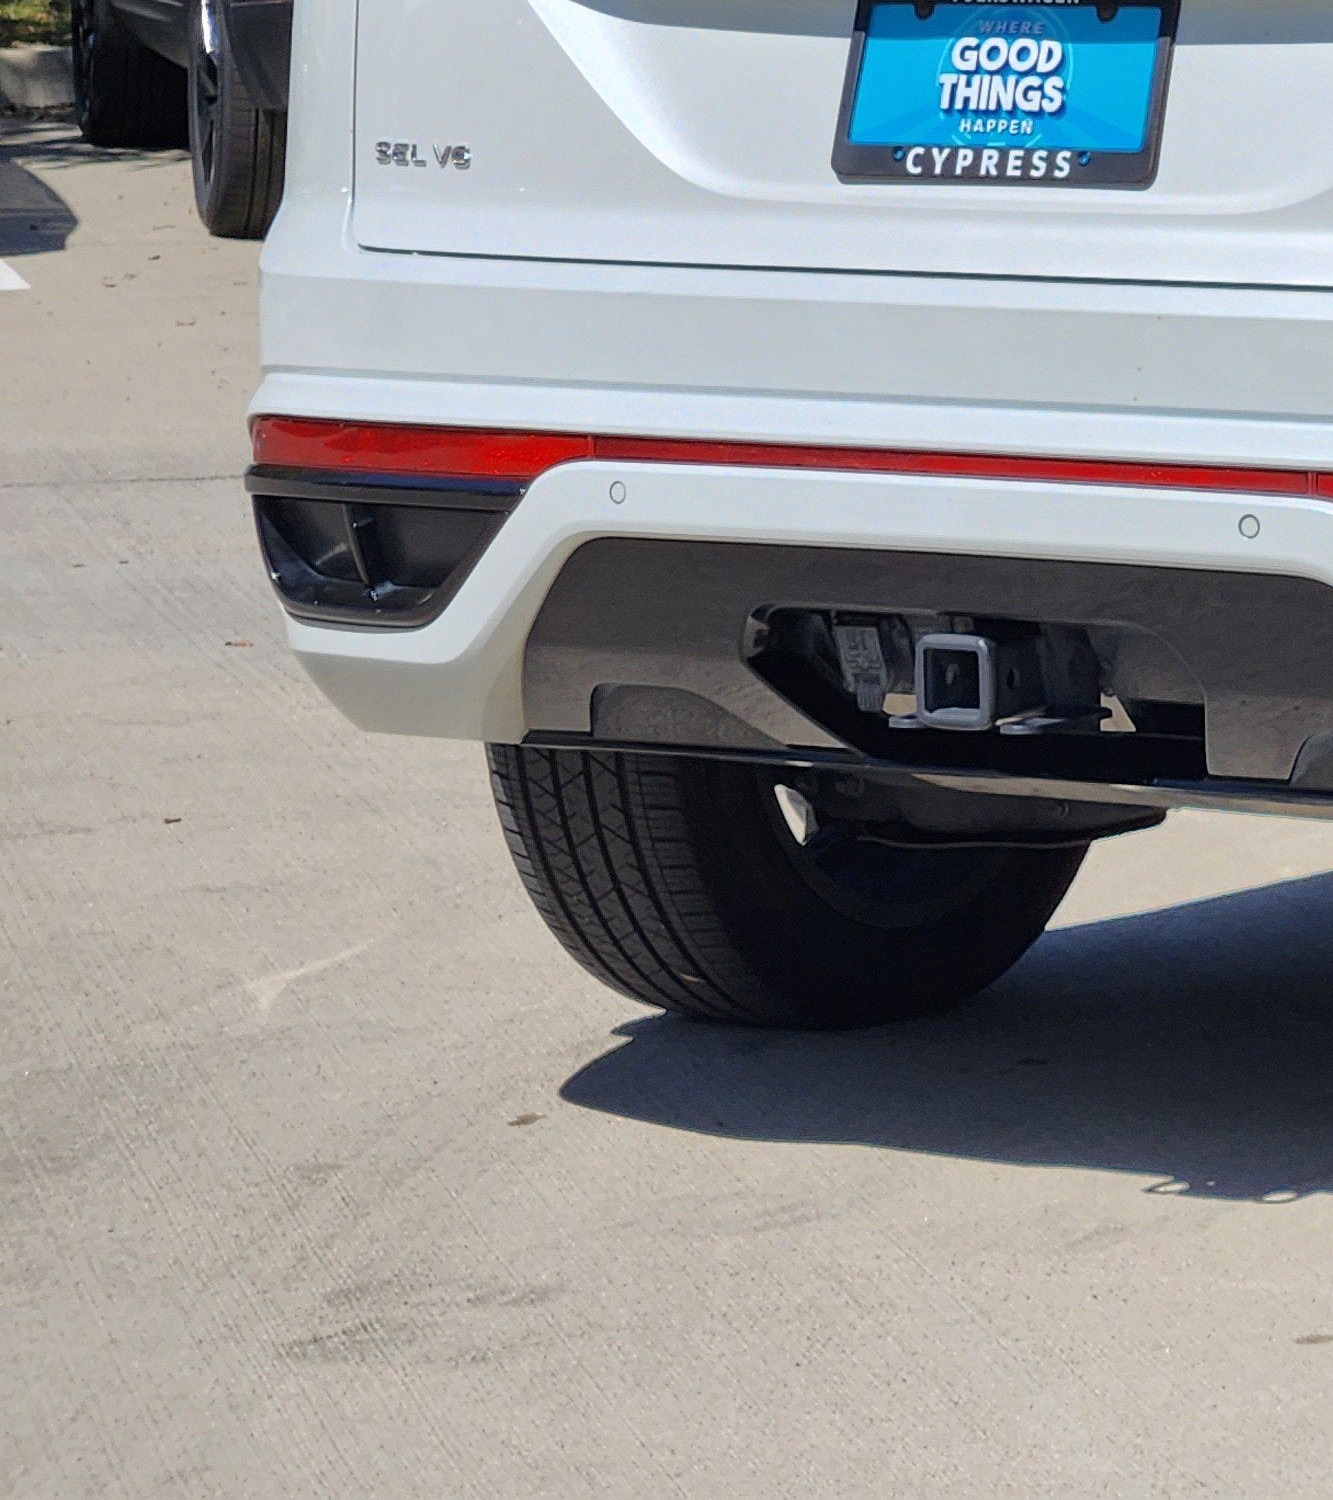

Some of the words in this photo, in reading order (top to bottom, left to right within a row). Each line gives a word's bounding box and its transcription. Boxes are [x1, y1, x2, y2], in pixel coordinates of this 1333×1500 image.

[978, 19, 1046, 36] WHERE
[950, 36, 1063, 73] GOOD
[938, 73, 1065, 115] THINGS
[958, 117, 1034, 136] HAPPEN
[375, 141, 427, 168] SEL
[905, 145, 1073, 179] CYPRESS
